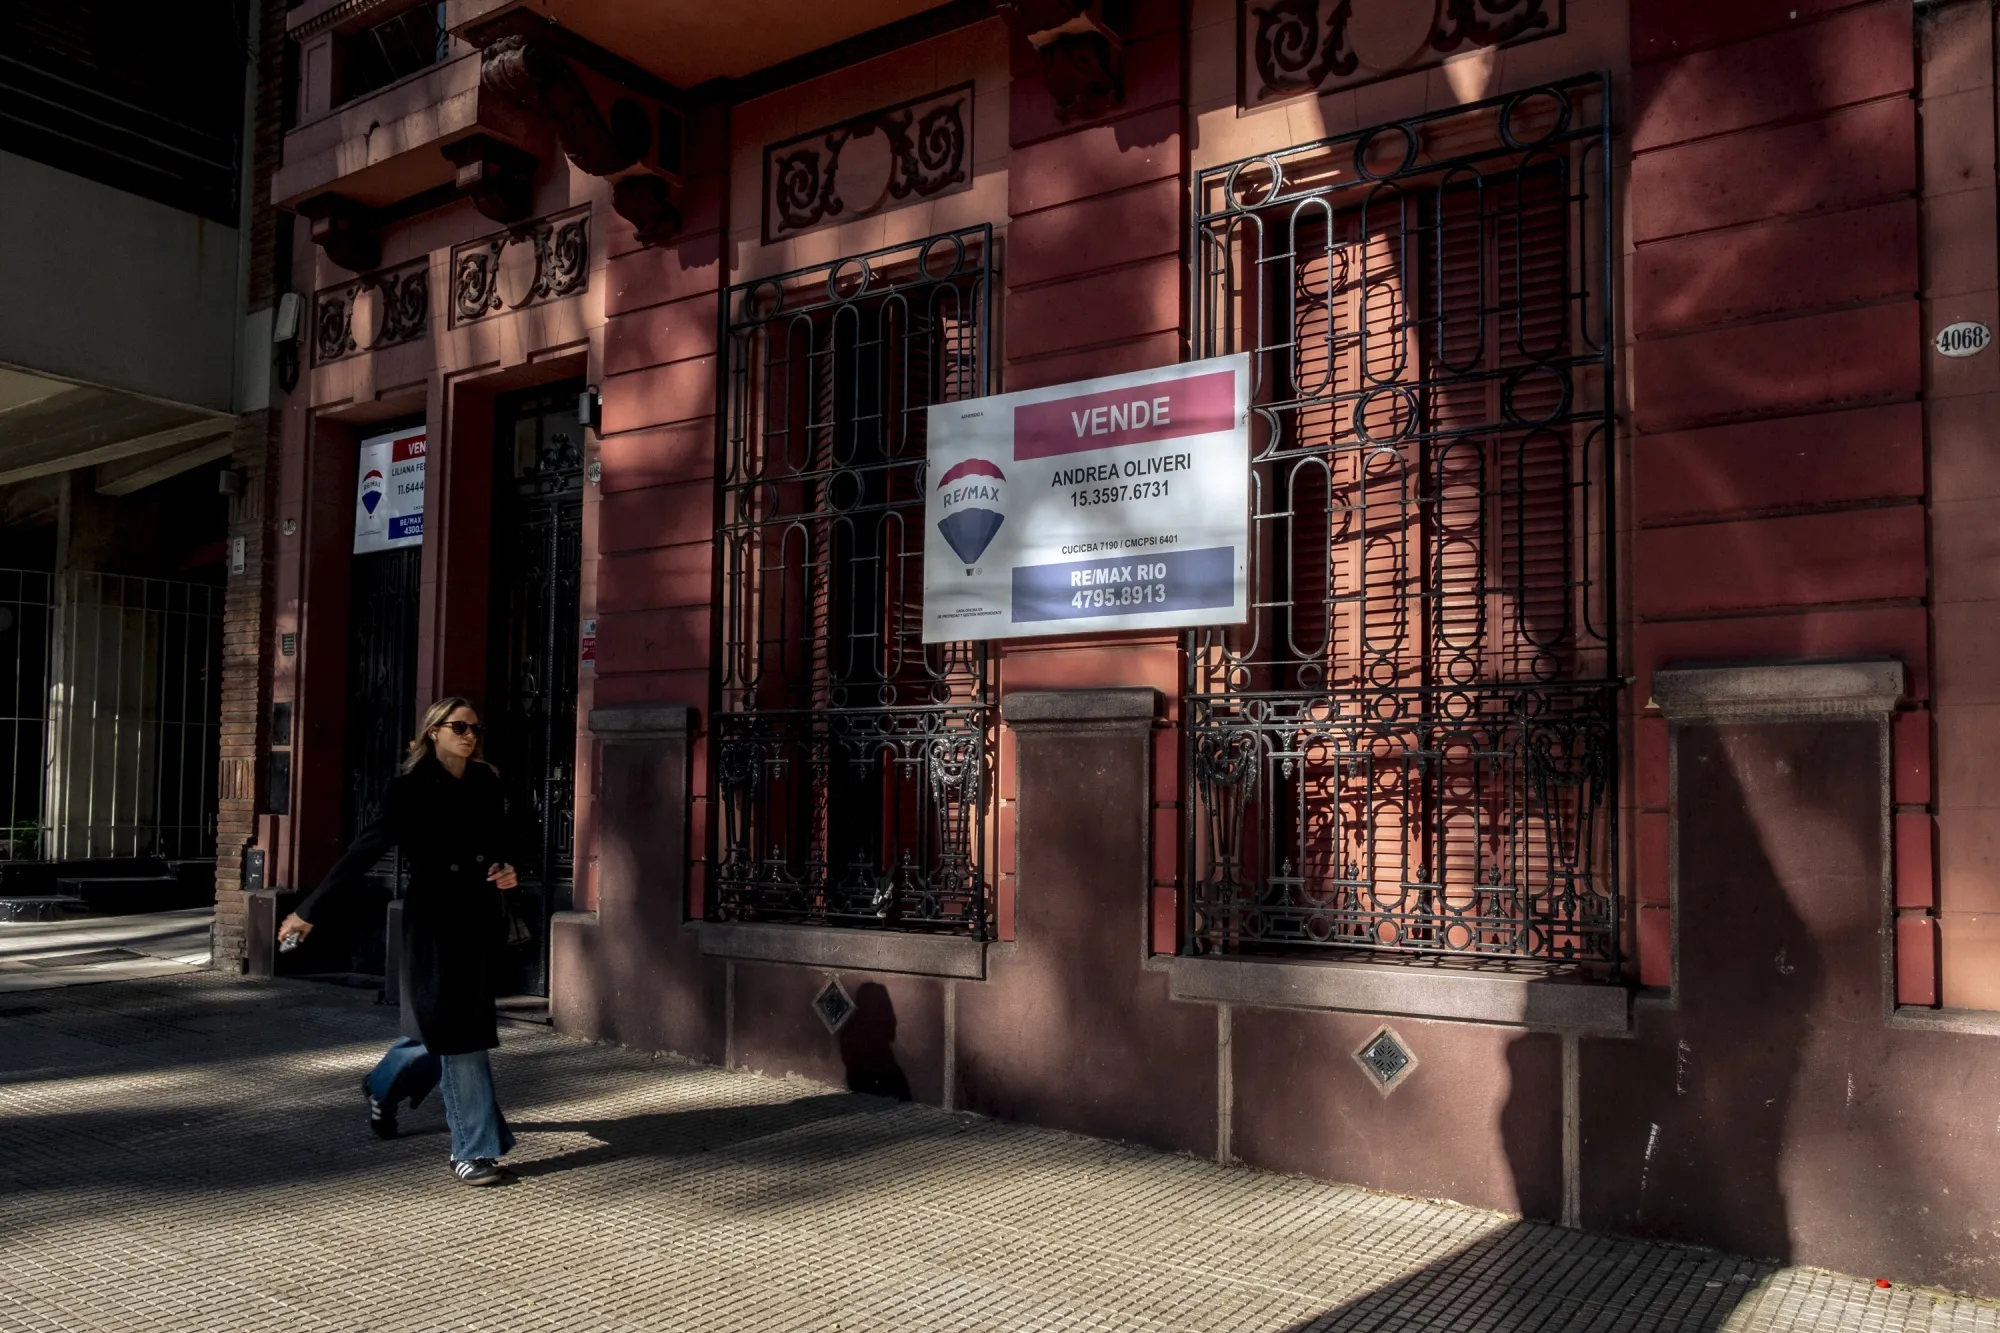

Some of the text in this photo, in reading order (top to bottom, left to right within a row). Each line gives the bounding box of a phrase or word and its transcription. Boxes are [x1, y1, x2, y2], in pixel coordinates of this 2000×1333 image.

[1941, 326, 1983, 352] 4068
[1071, 396, 1170, 438] VENDE
[392, 464, 415, 477] LILIANA
[1051, 453, 1191, 487] ANDREA OLIVERI
[943, 485, 1000, 508] RE/MAX
[1070, 480, 1169, 507] 15.3597.6731
[1061, 543, 1098, 555] CUCICBA
[1100, 540, 1118, 551] 7190
[1124, 537, 1158, 548] CMCPSI
[1159, 534, 1178, 545] 6401
[1071, 563, 1167, 587] RE/MAX RIO
[1071, 584, 1166, 609] 4795.8913
